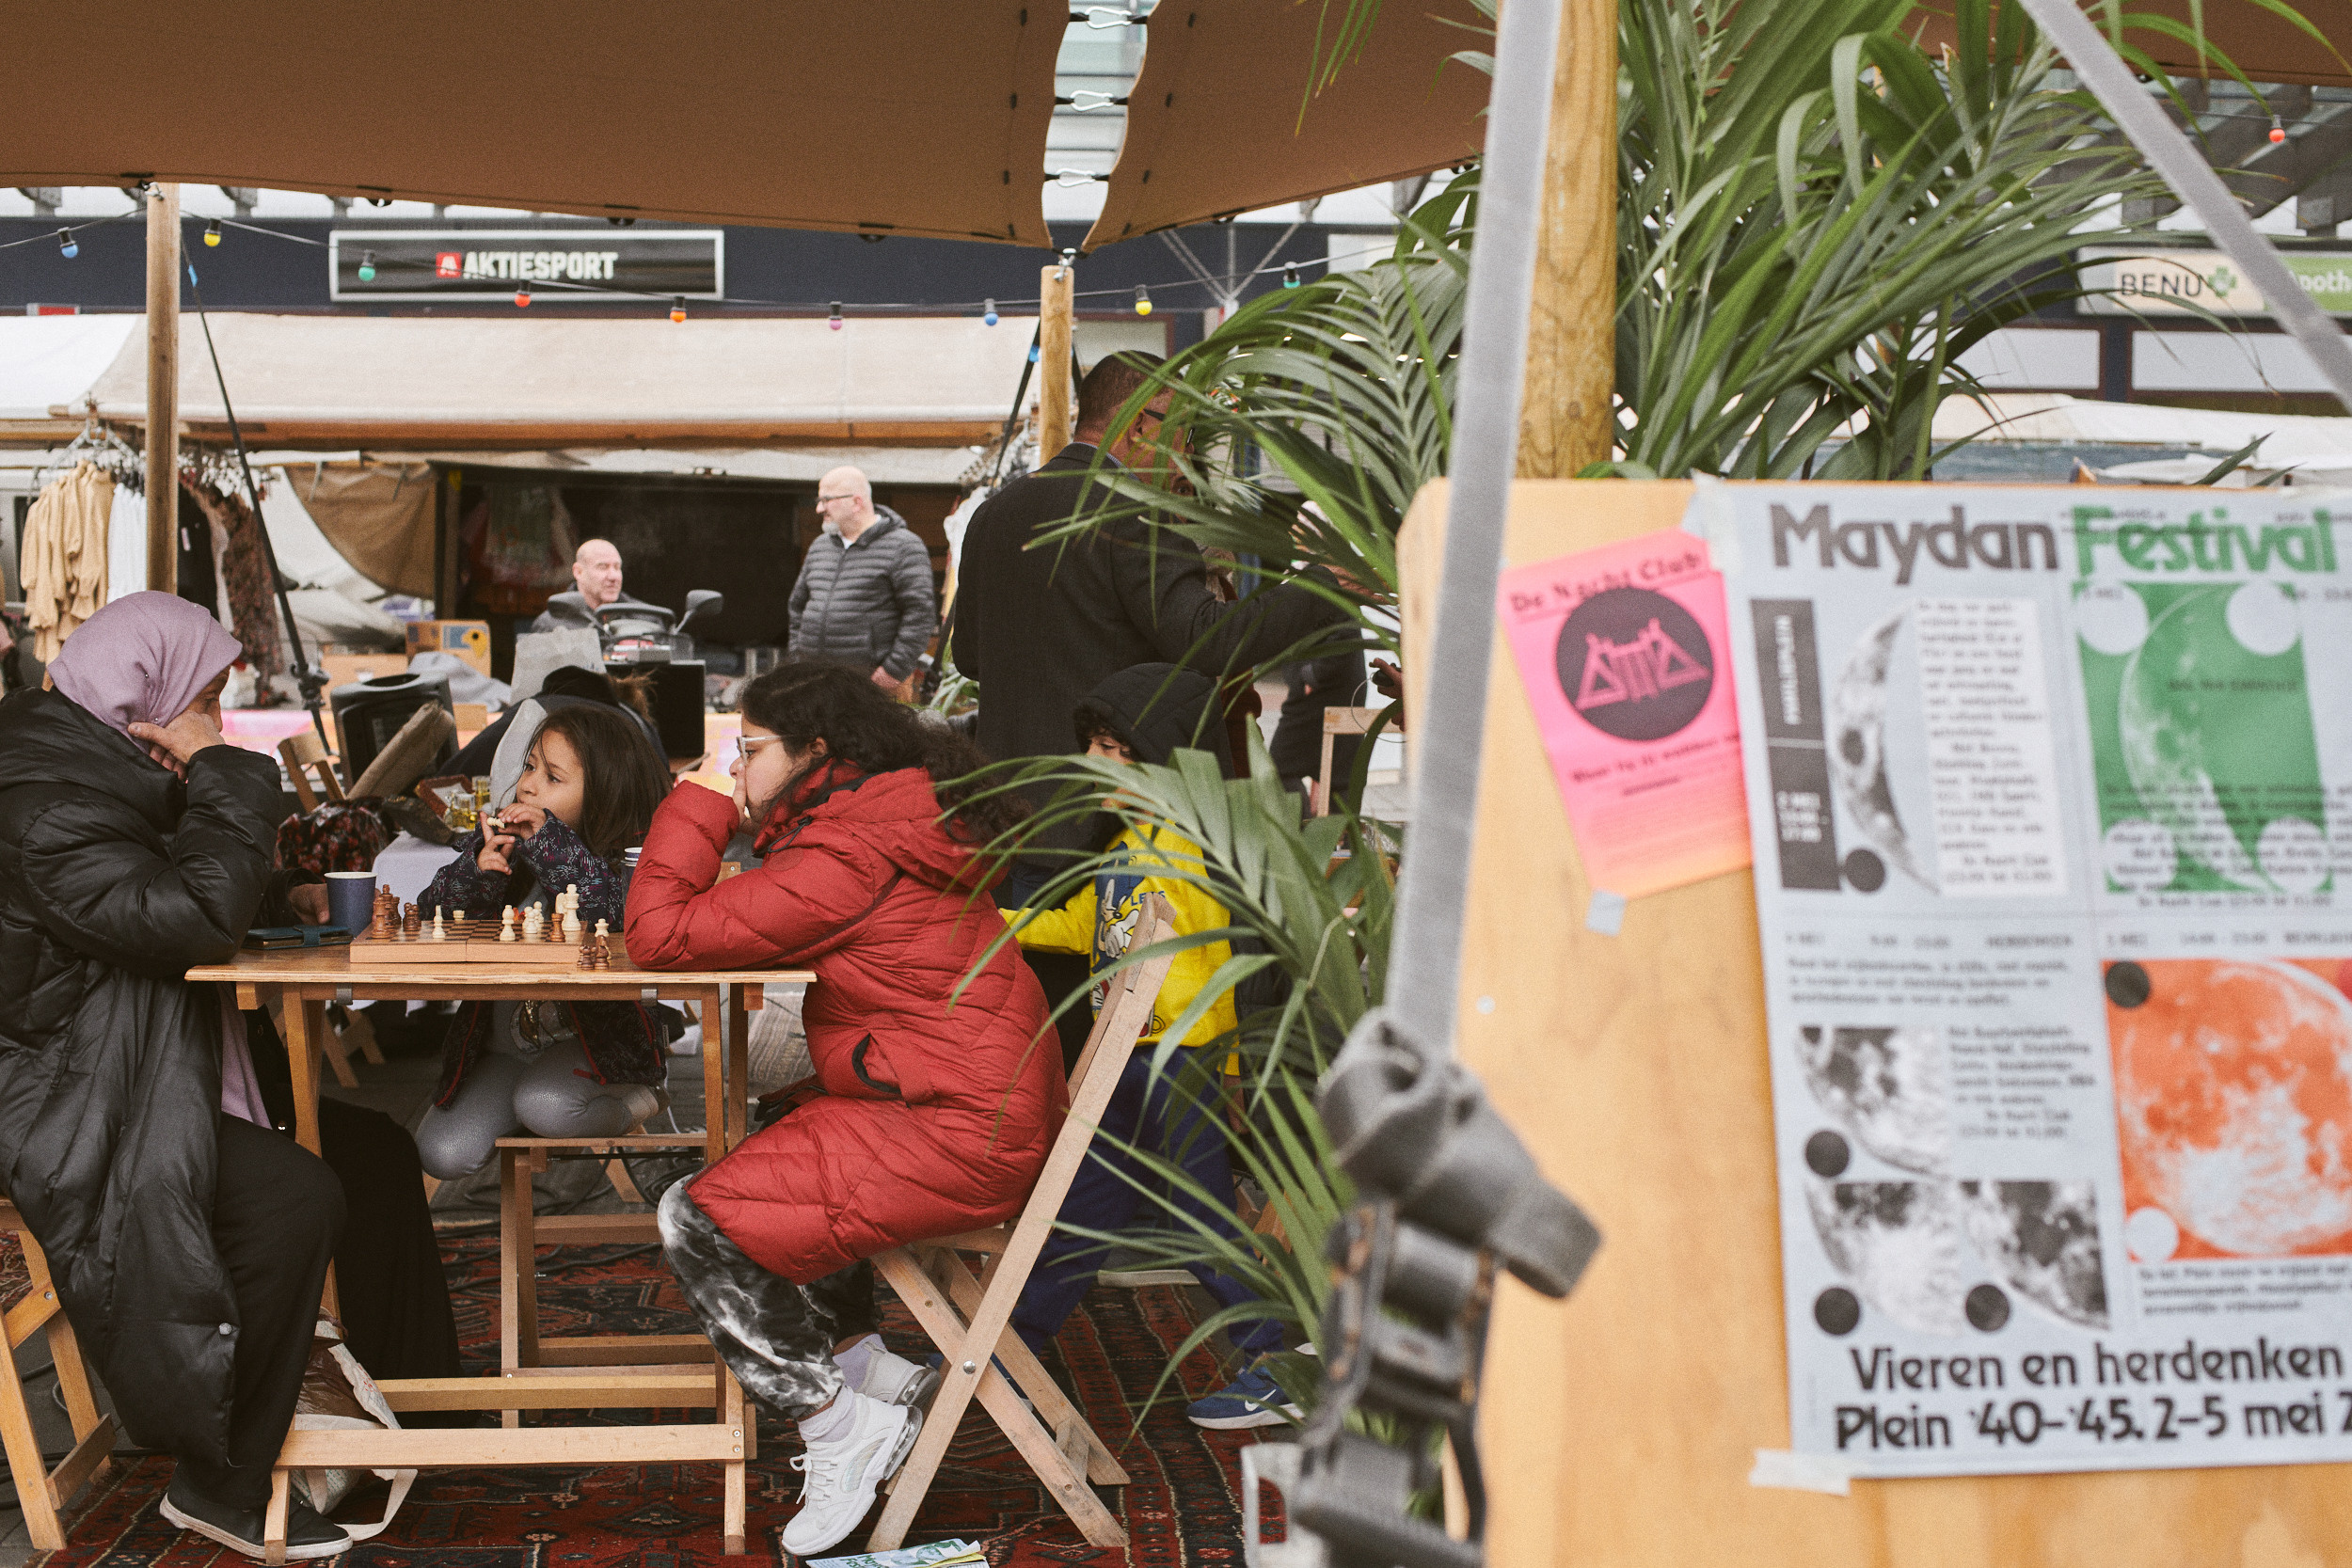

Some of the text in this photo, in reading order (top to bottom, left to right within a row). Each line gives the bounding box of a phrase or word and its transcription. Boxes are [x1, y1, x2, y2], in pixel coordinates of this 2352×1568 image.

[463, 251, 618, 279] AKTIESPORT
[2121, 272, 2201, 296] BENU
[1770, 504, 2339, 585] Maydan Festival
[1850, 1336, 2343, 1390] Vieren en herdenken
[1836, 1403, 1950, 1449] Plein
[2244, 1390, 2323, 1436] mei
